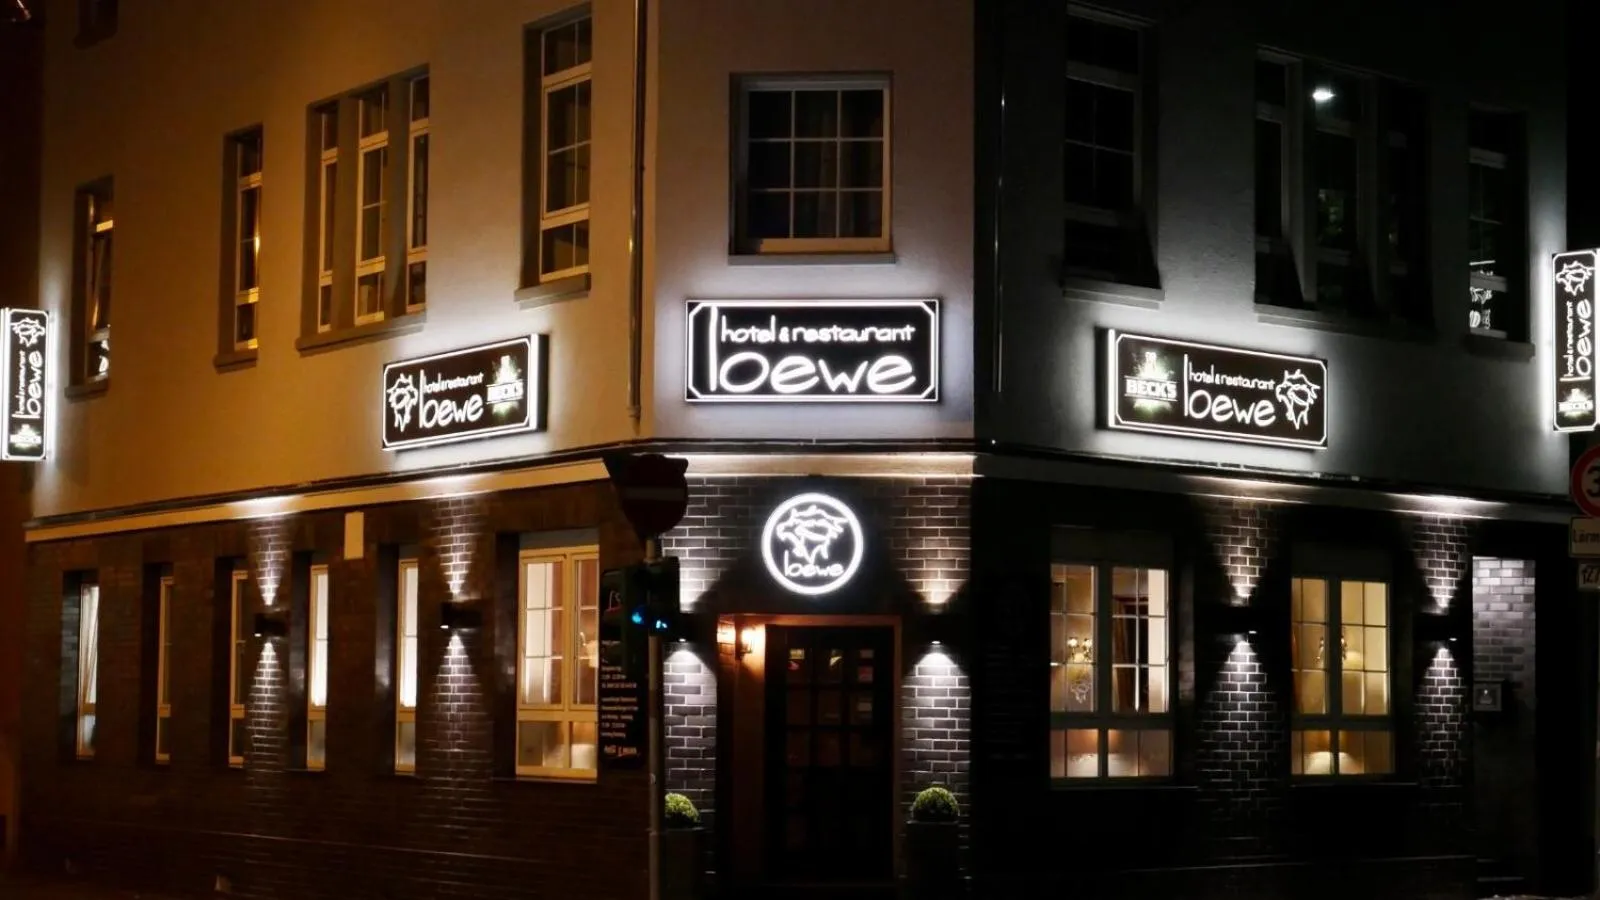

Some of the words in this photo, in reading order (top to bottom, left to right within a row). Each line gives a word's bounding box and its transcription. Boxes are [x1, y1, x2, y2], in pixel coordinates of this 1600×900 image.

[708, 304, 917, 394] loewe
[721, 314, 776, 343] hotel
[792, 323, 916, 343] restaurant
[1559, 299, 1592, 382] loewe
[12, 350, 43, 419] loewe
[419, 369, 484, 429] loewe
[1125, 378, 1178, 399] BECK'S
[1183, 353, 1277, 427] loewe
[1188, 361, 1214, 384] hotel
[1220, 372, 1276, 391] restaurant
[783, 549, 844, 578] loewe
